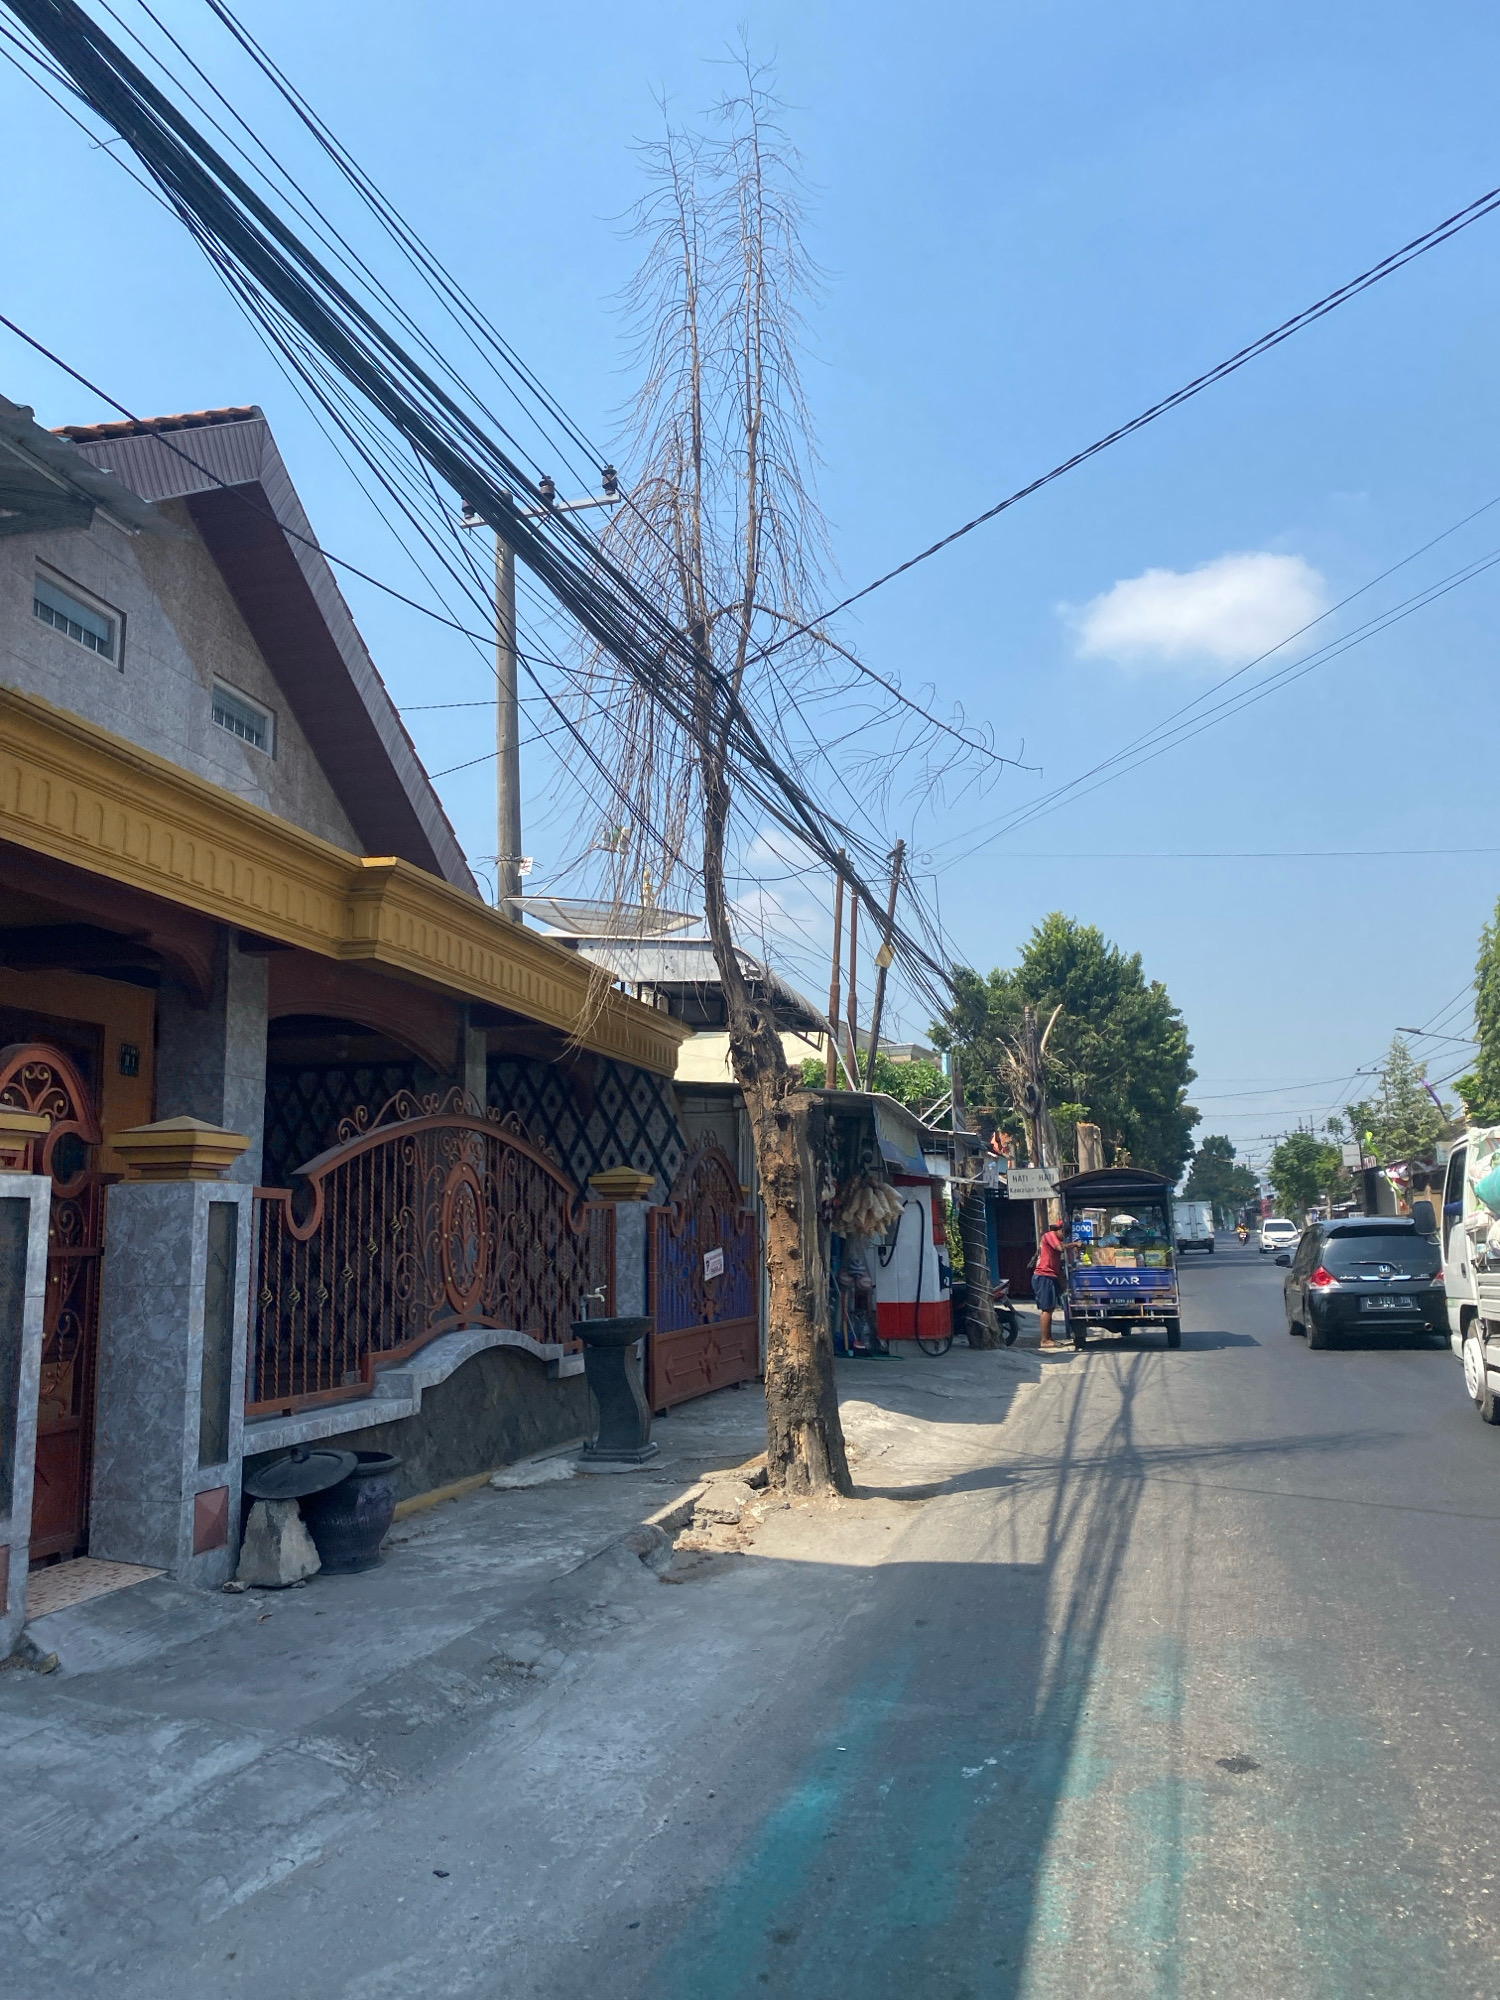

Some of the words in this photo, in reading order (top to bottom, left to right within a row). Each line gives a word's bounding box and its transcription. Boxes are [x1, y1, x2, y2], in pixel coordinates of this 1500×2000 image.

[1012, 1174, 1029, 1183] HATI
[1038, 1173, 1055, 1182] HATI
[1104, 1277, 1141, 1285] VIAR
